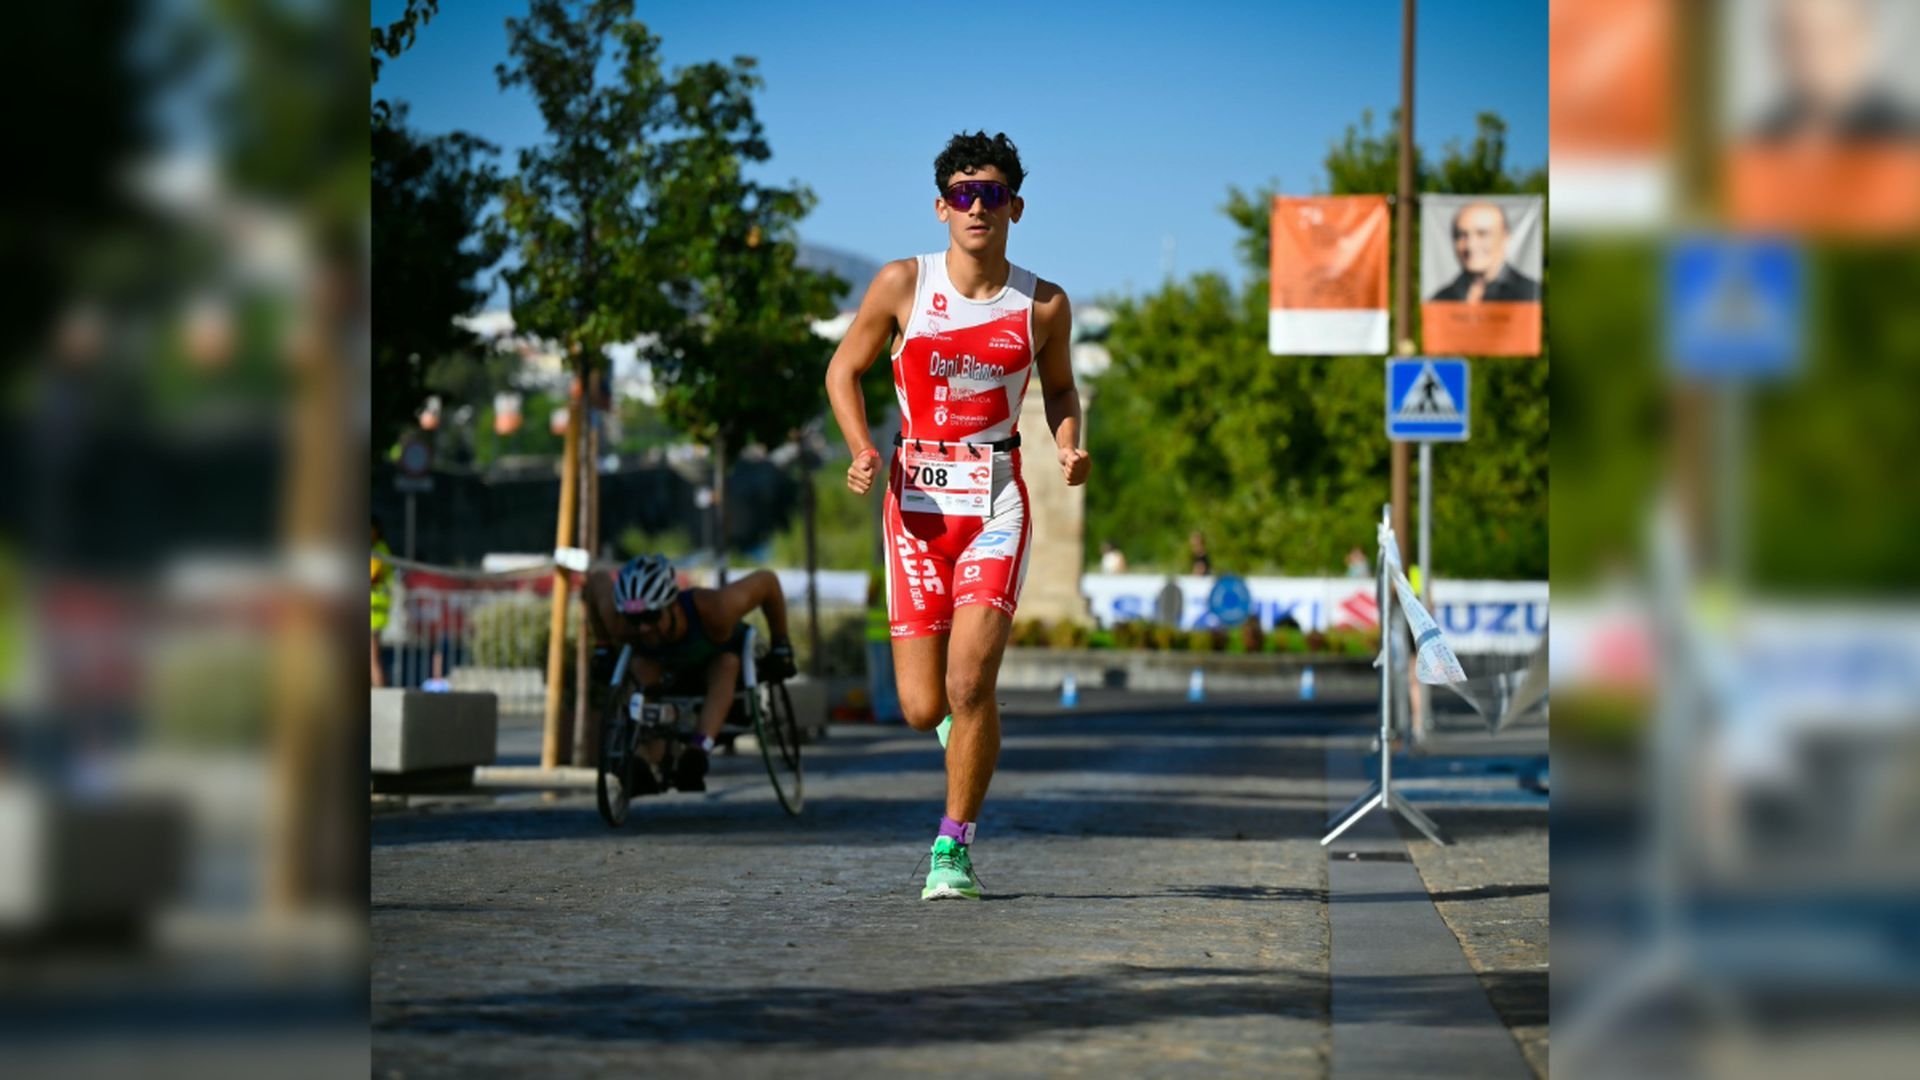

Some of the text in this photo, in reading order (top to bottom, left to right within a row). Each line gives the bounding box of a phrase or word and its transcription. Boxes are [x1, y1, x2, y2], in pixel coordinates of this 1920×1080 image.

[930, 351, 1005, 381] Dani Blanco
[908, 465, 948, 487] 708
